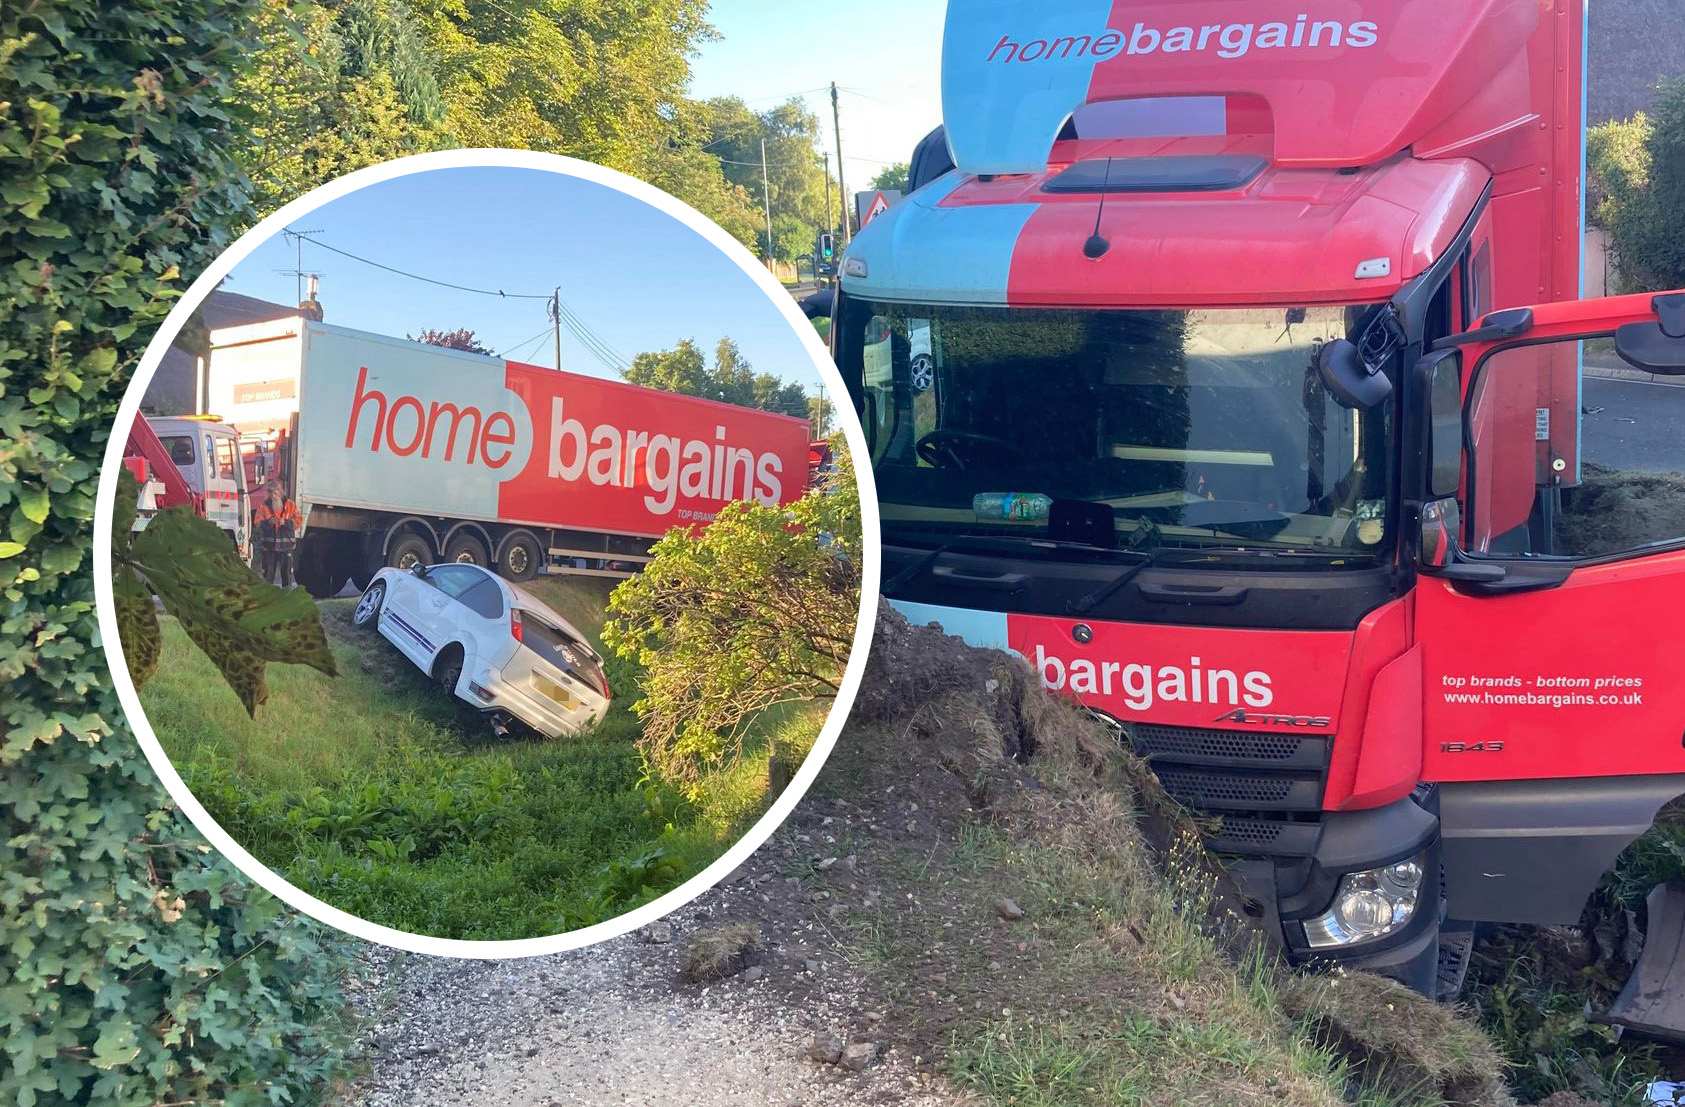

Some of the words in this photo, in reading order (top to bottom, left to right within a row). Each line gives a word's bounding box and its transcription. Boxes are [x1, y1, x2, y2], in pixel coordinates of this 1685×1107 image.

[986, 33, 1121, 63] home
[1127, 14, 1378, 58] bargains
[345, 366, 516, 469] home
[548, 396, 783, 515] bargains
[677, 508, 692, 519] TOP
[693, 511, 718, 522] BRAN
[1036, 644, 1274, 711] bargains
[1442, 675, 1466, 688] top
[1470, 675, 1522, 687] brands
[1536, 676, 1590, 687] bottom
[1594, 675, 1642, 689] prices
[1444, 691, 1642, 708] www.homebargains.co.uk
[1213, 707, 1331, 727] ACTROS
